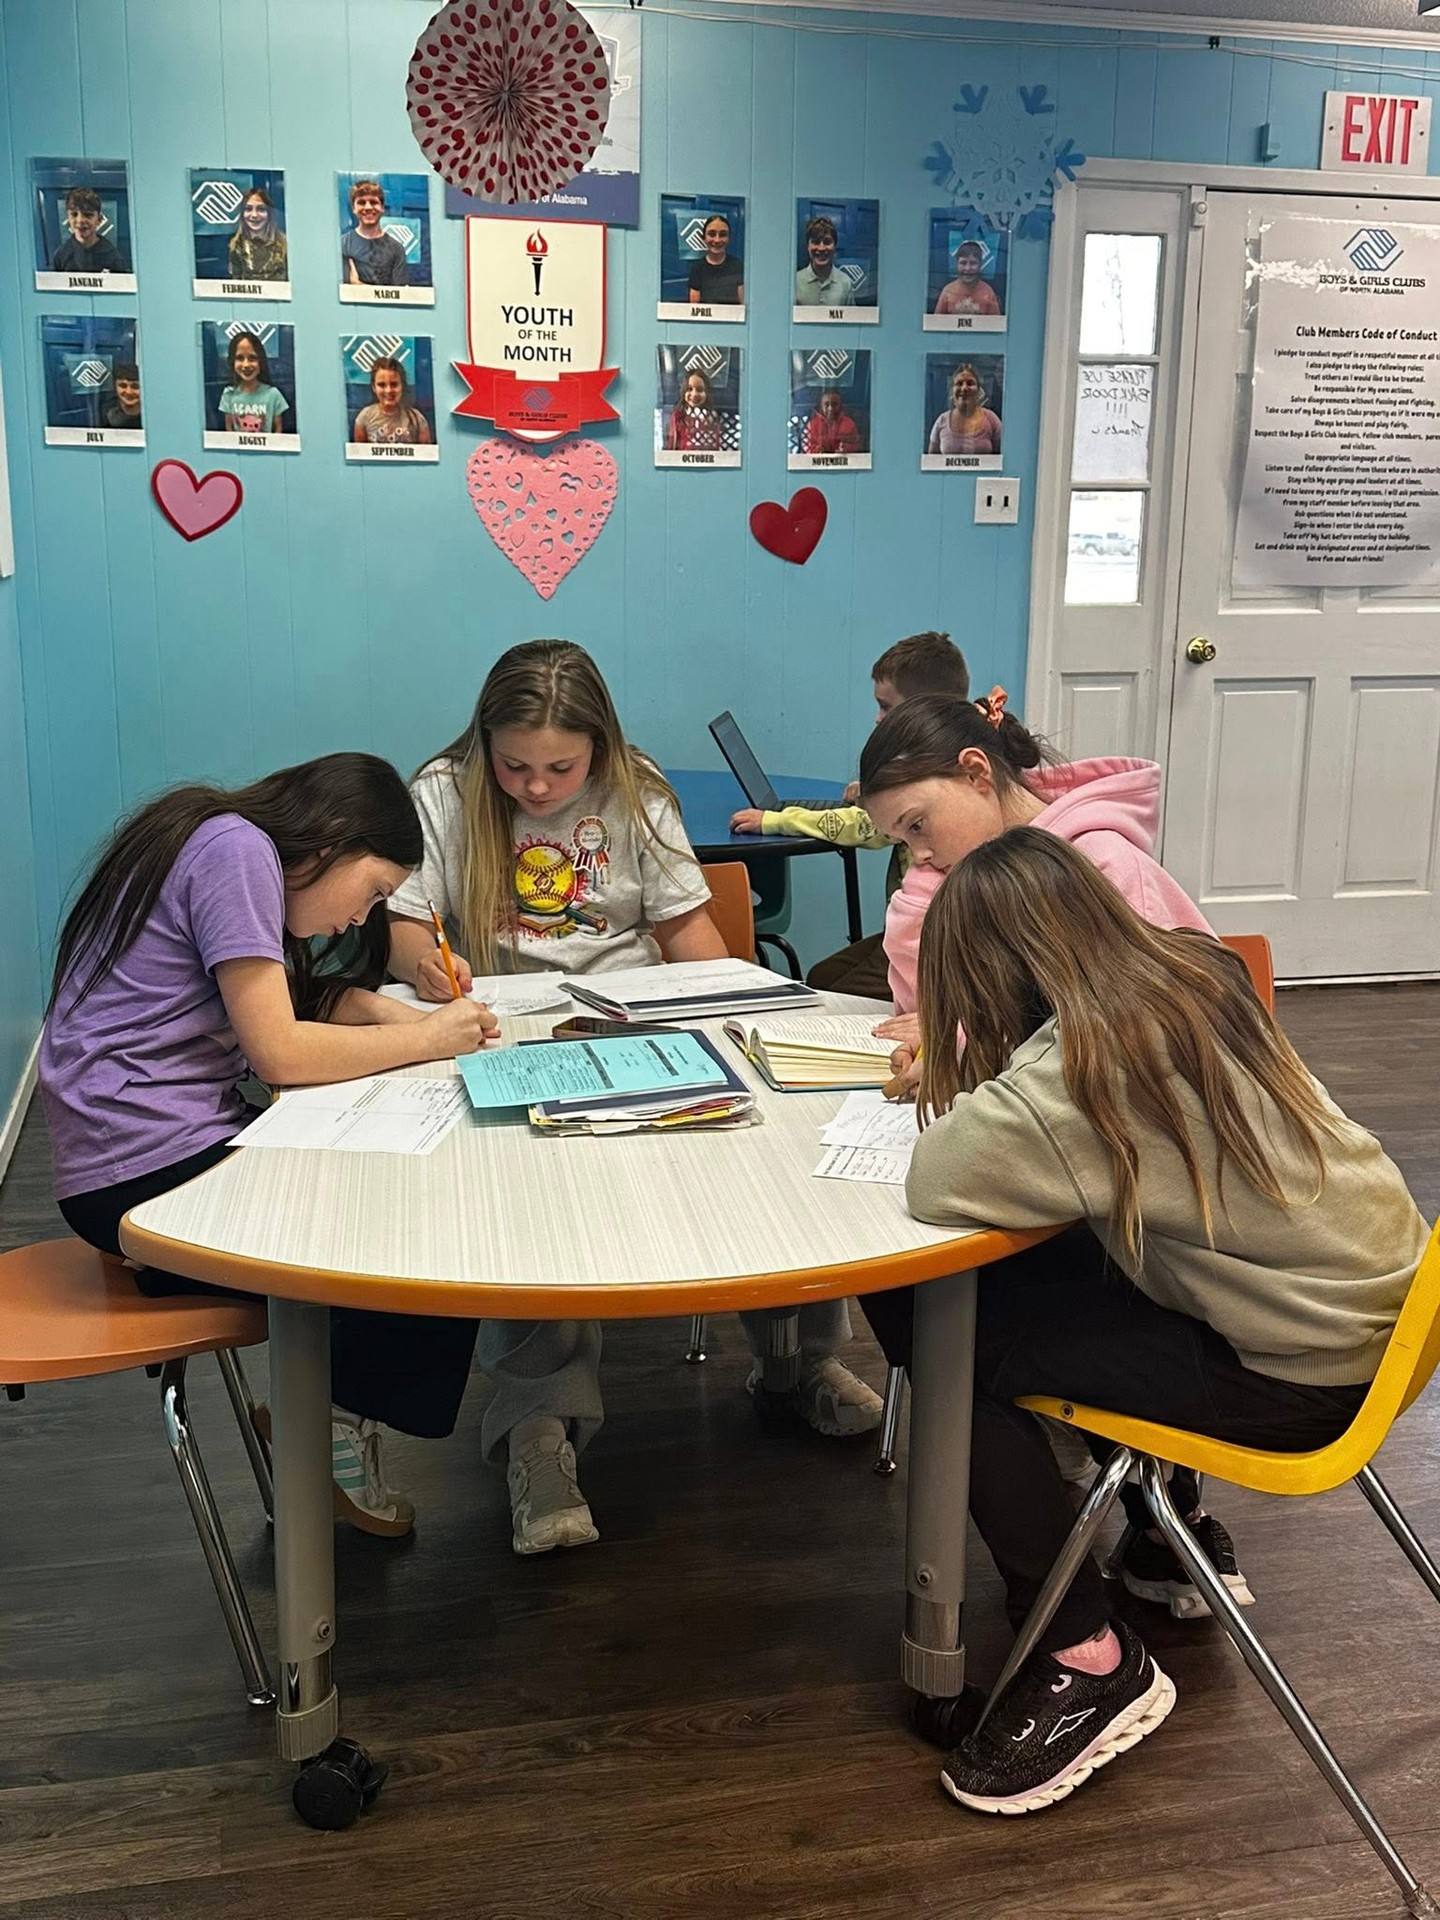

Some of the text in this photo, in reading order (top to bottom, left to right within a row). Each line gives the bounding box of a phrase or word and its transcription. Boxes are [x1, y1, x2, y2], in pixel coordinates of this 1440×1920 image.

[1341, 95, 1419, 165] EXIT
[552, 193, 588, 205] Alabama
[68, 277, 104, 288] JANUARY
[1319, 274, 1425, 287] BOYS & GIRLS CLUBS
[222, 283, 263, 295] FEBRUARY
[373, 289, 400, 300] MARCH
[1372, 287, 1404, 295] ALABAMA
[501, 305, 573, 327] YOUTH
[690, 307, 713, 317] APRIL
[828, 309, 844, 320] MAY
[957, 318, 973, 328] JUNE
[518, 329, 557, 341] OF THE
[1296, 325, 1437, 340] Club Members Code of Conduct
[504, 345, 572, 363] MONTH
[1277, 349, 1297, 358] pledge
[1306, 349, 1330, 357] conduct
[1331, 350, 1352, 359] myself
[1364, 351, 1396, 360] respectful
[1322, 362, 1342, 370] pledge
[1351, 363, 1366, 371] obey
[1378, 363, 1406, 372] following
[1304, 372, 1320, 380] Treat
[1400, 375, 1425, 383] treated.
[1322, 384, 1355, 394] responsible
[1367, 386, 1376, 394] My
[1291, 395, 1306, 403] Solve
[1375, 397, 1397, 406] fussing
[1410, 398, 1435, 407] fighting.
[86, 432, 104, 443] JULY
[238, 435, 267, 447] AUGUST
[371, 446, 415, 457] SEPTEMBER
[682, 453, 715, 464] OCTOBER
[812, 456, 848, 467] NOVEMBER
[945, 457, 980, 467] DECEMBER
